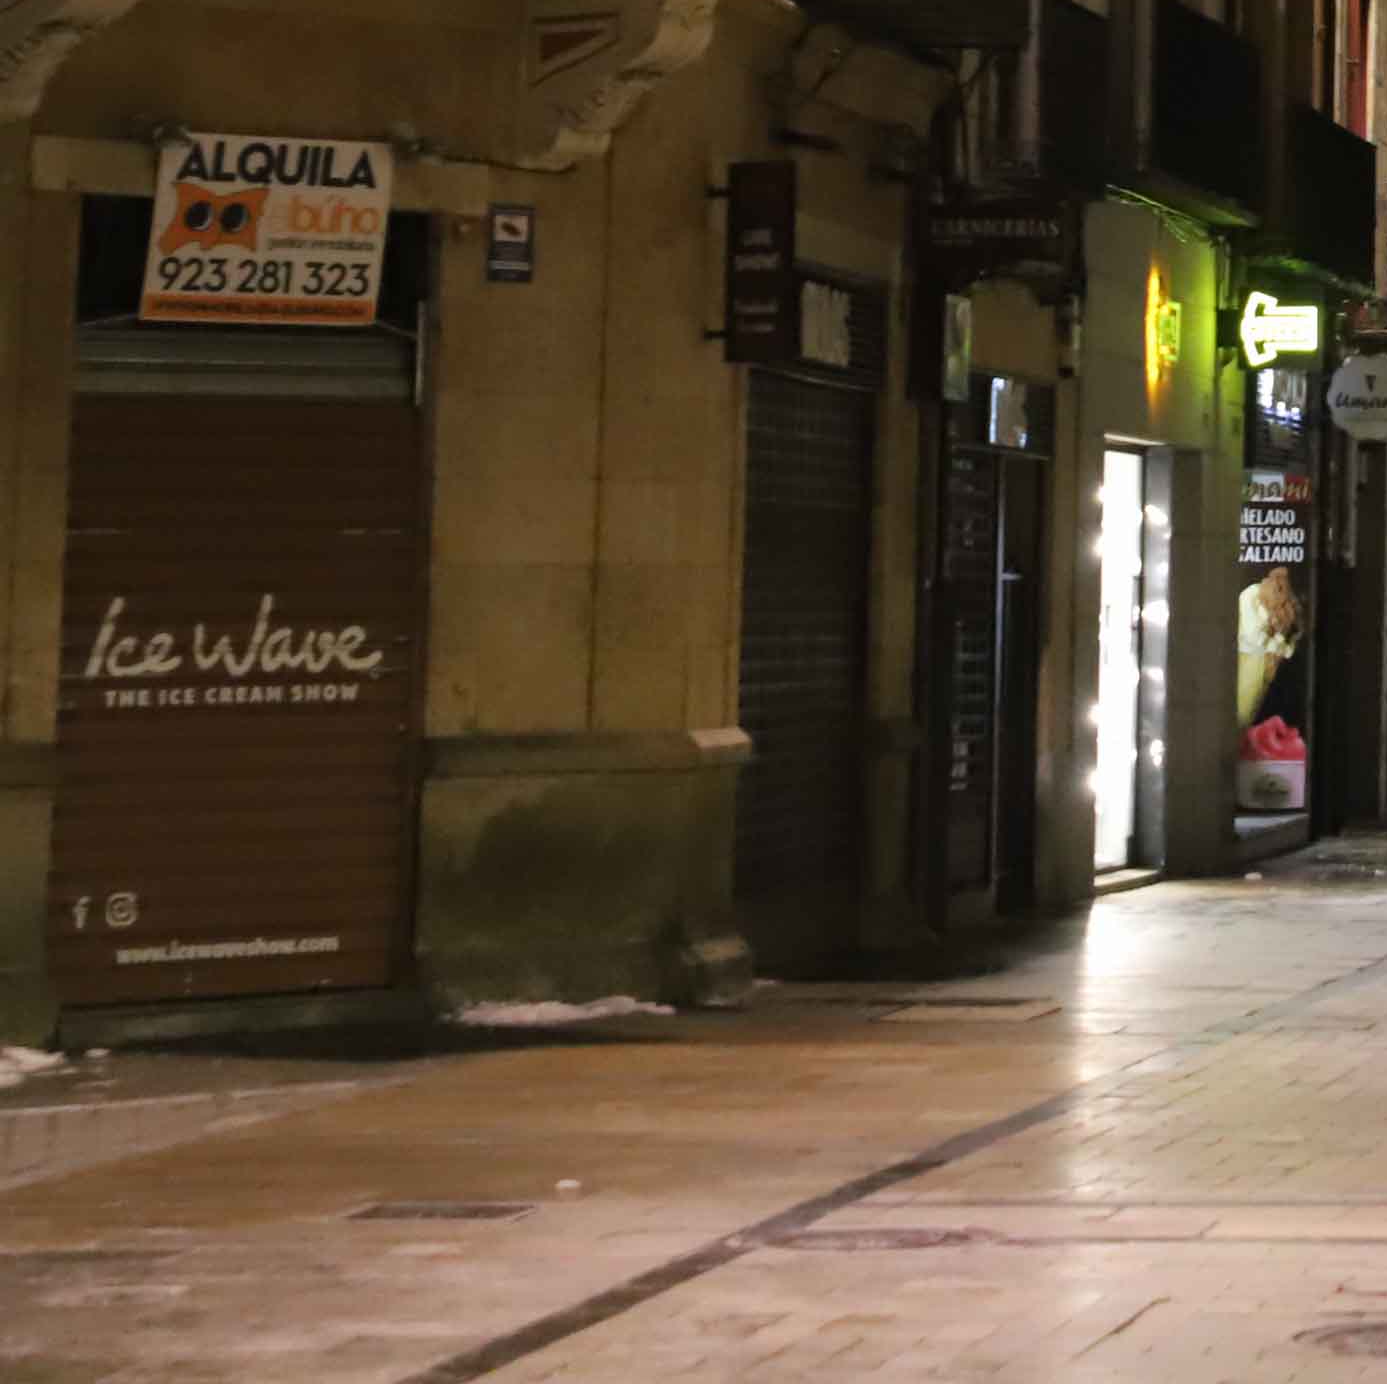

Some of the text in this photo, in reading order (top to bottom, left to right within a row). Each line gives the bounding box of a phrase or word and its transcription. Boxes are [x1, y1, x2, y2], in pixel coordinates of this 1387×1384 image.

[176, 141, 375, 188] ALQUILA
[159, 257, 370, 296] 923 281 323
[83, 592, 384, 679] Ice Wave
[104, 682, 360, 708] THE ICE CREAM SHOW
